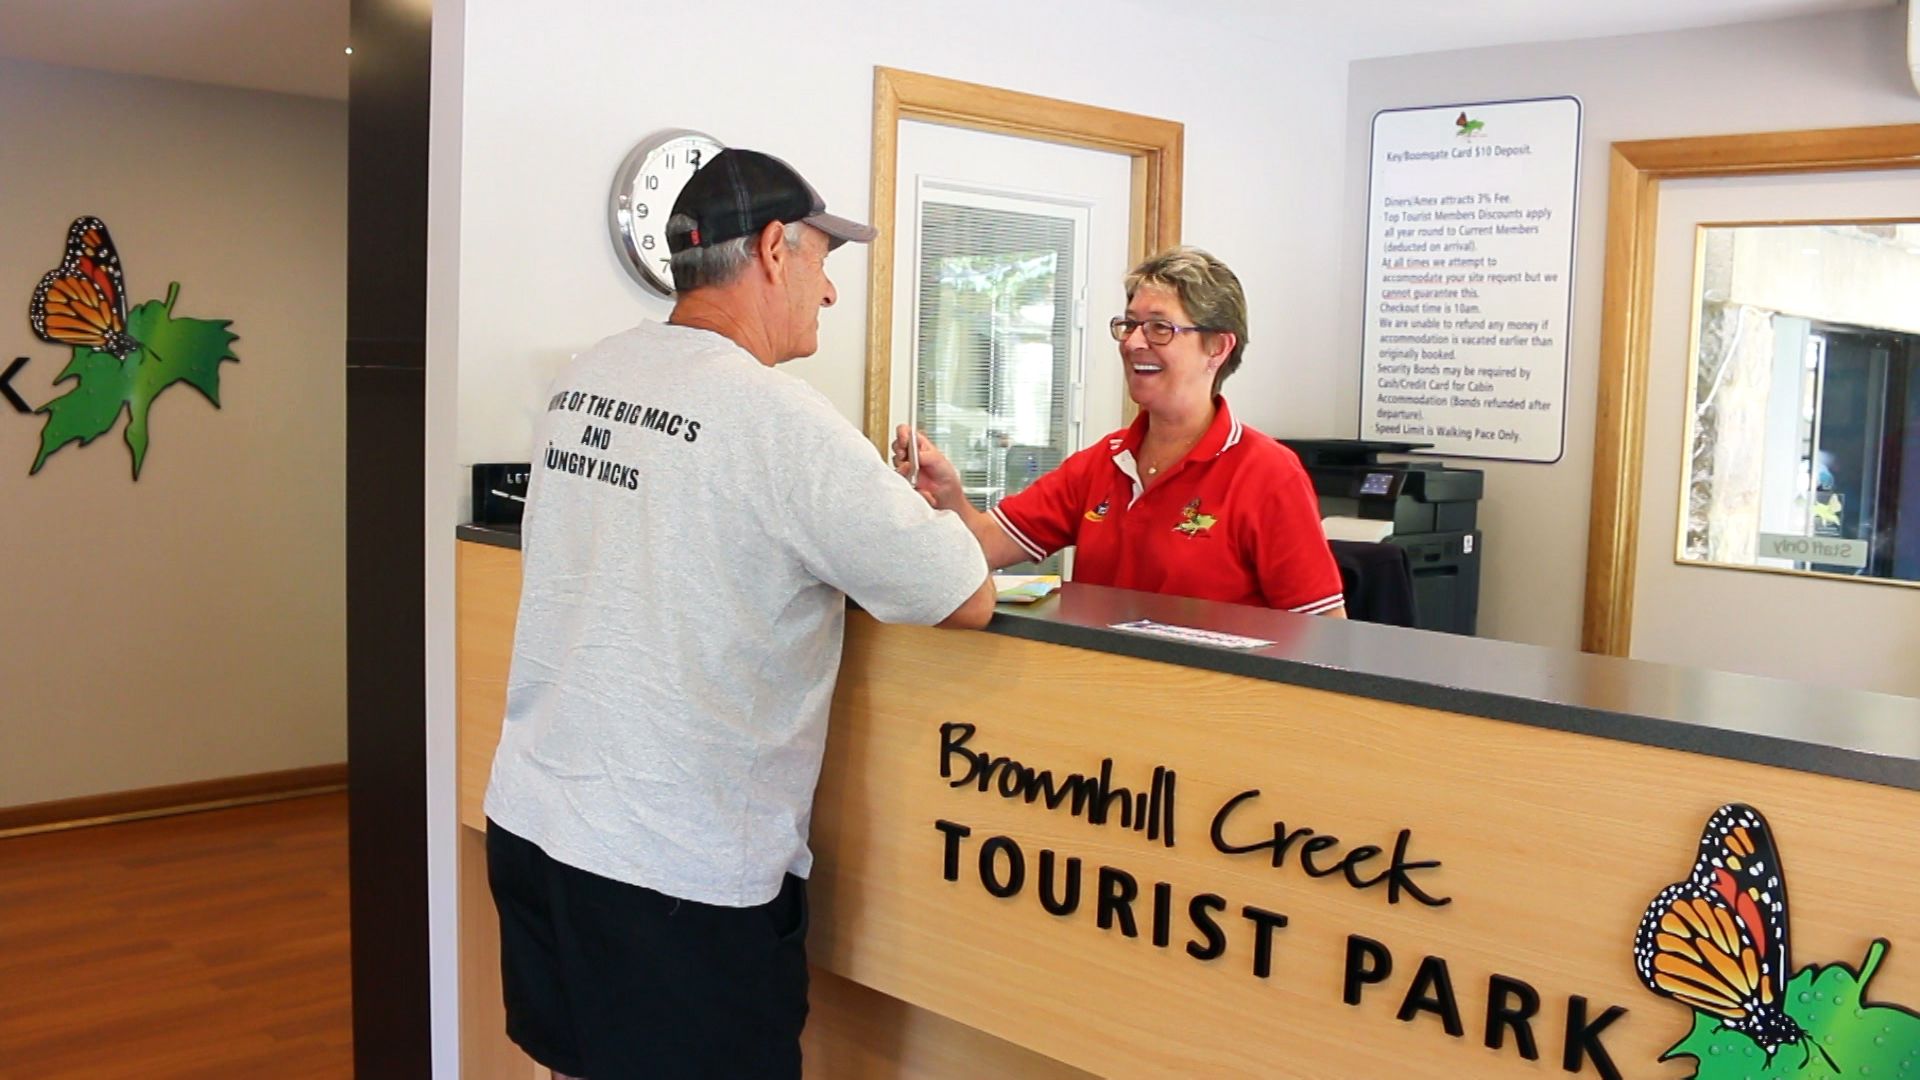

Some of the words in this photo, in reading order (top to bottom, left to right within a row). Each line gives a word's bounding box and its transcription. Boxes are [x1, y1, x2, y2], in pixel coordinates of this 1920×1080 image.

[1451, 147, 1472, 158] Card
[1475, 146, 1493, 157] $10
[665, 153, 675, 169] 11
[646, 176, 658, 190] 10
[1440, 195, 1474, 205] attracts
[1477, 193, 1492, 204] 3%
[637, 203, 649, 218] 9
[1384, 212, 1400, 223] Top
[1402, 211, 1432, 222] Tourist
[1434, 210, 1475, 221] Members
[1478, 208, 1523, 220] Discounts
[1525, 207, 1552, 220] apply
[1384, 227, 1394, 237] all
[1396, 228, 1415, 239] year
[1417, 226, 1444, 237] round
[1446, 226, 1457, 236] to
[1458, 225, 1493, 236] Current
[1496, 223, 1539, 235] Members
[642, 235, 655, 250] 8
[1429, 242, 1441, 252] on
[659, 258, 671, 273] 7
[1393, 257, 1404, 267] all
[1406, 257, 1430, 267] times
[1432, 257, 1445, 267] we
[1448, 257, 1485, 269] attempt
[1487, 257, 1497, 267] to
[1382, 273, 1443, 284] accommodate
[1445, 273, 1466, 285] your
[1468, 272, 1484, 282] site
[1487, 272, 1522, 285] request
[1524, 272, 1541, 282] but
[1544, 274, 1559, 282] we
[1381, 288, 1412, 299] cannot
[1413, 289, 1458, 301] guarantee
[1379, 303, 1420, 314] Checkout
[1422, 303, 1441, 313] time
[1444, 304, 1452, 314] is
[1379, 318, 1393, 328] We
[1395, 319, 1409, 328] are
[1411, 318, 1440, 329] unable
[1443, 319, 1454, 329] to
[1455, 319, 1485, 330] refund
[1487, 321, 1504, 332] any
[1507, 321, 1538, 332] money
[1541, 319, 1549, 331] if
[1379, 333, 1449, 345] accommodation
[1452, 334, 1459, 345] is
[1461, 335, 1497, 346] vacated
[1499, 335, 1529, 346] earlier
[1531, 336, 1553, 346] than
[1379, 349, 1419, 361] originally
[1377, 363, 1411, 376] Security
[1413, 365, 1440, 374] Bonds
[1442, 366, 1462, 377] may
[1464, 366, 1475, 376] be
[1477, 367, 1517, 379] required
[1519, 367, 1531, 380] by
[1377, 378, 1427, 389] Cash/Credit
[1429, 379, 1450, 391] Card
[1452, 380, 1466, 391] for
[1468, 381, 1494, 392] Cabin
[1377, 393, 1448, 406] Accommodation
[1483, 399, 1525, 410] refunded
[1528, 400, 1551, 411] after
[567, 391, 588, 412] OF
[586, 394, 616, 419] THE
[614, 401, 642, 425] BIG
[640, 407, 701, 443] MAC'S
[581, 425, 612, 450] AND
[1375, 424, 1401, 434] Speed
[1403, 425, 1425, 435] Limit
[1427, 426, 1435, 436] is
[1436, 427, 1472, 440] Walking
[1475, 429, 1496, 439] Pace
[598, 459, 640, 491] JACKS
[939, 721, 1176, 848] Brownhill
[1210, 788, 1452, 908] Creek
[934, 818, 1289, 979] TOURIST
[1342, 932, 1628, 1080] PARK
